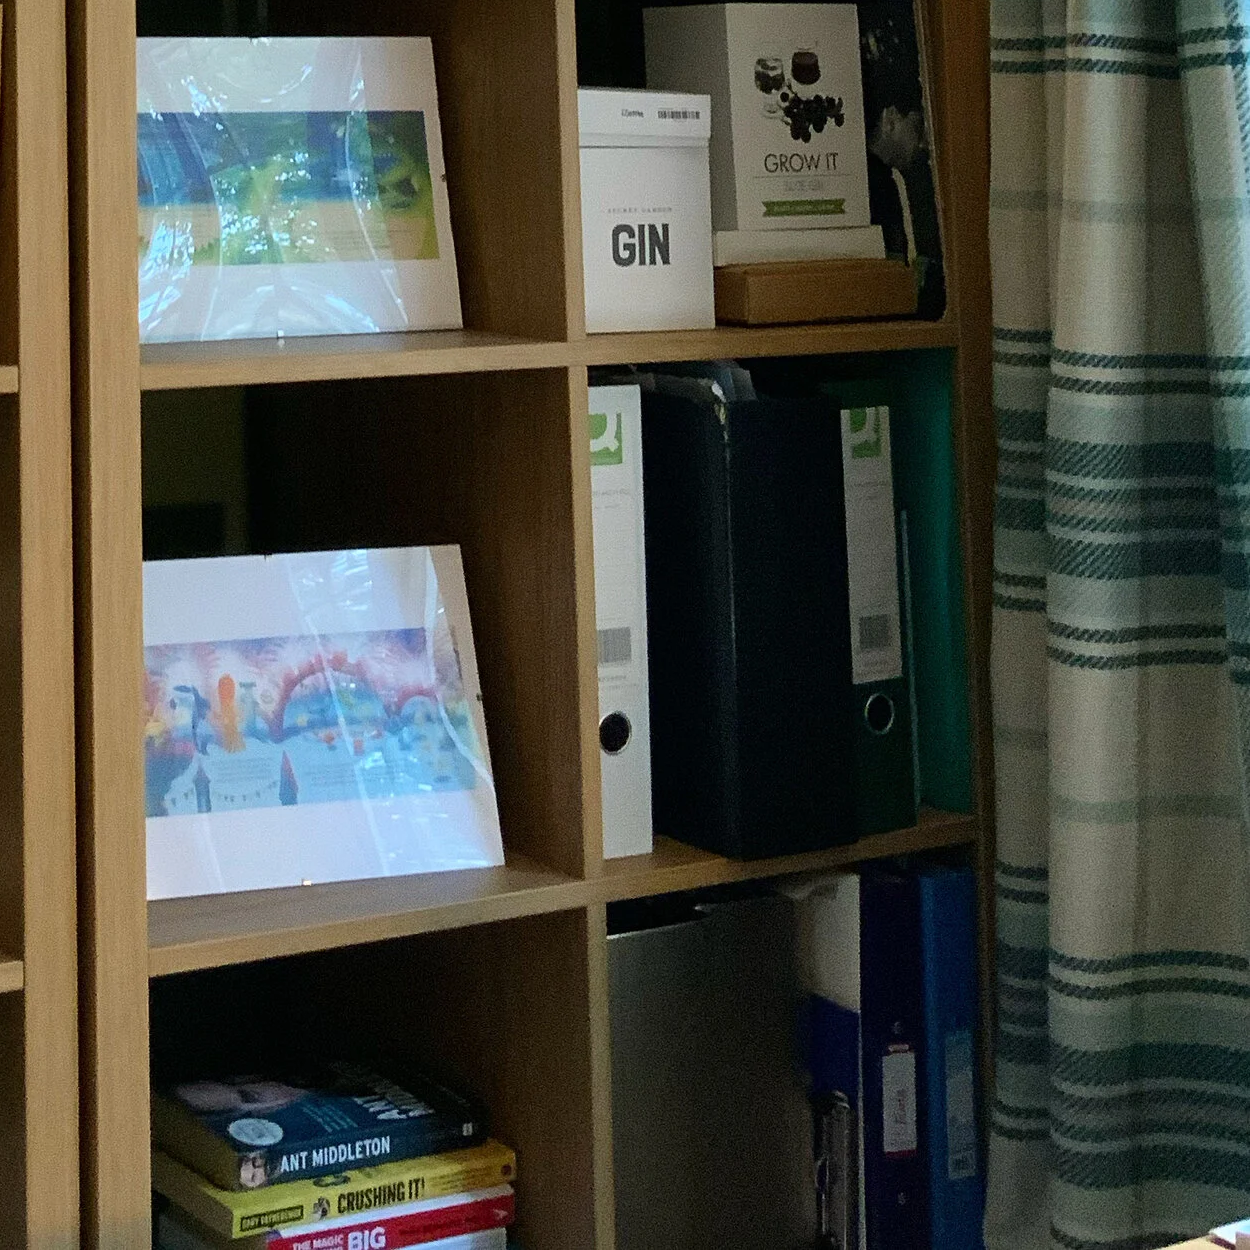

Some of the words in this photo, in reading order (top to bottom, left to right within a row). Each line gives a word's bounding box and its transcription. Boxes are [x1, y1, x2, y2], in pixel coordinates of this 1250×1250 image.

[764, 152, 821, 173] GROW
[825, 152, 839, 171] IT
[611, 223, 671, 267] GIN
[280, 1151, 309, 1173] ANT
[312, 1135, 391, 1168] MIDDLETON
[337, 1181, 406, 1214] CRUSHING
[408, 1176, 426, 1200] IT!
[313, 1234, 344, 1248] MAGIC
[348, 1226, 386, 1250] BIG
